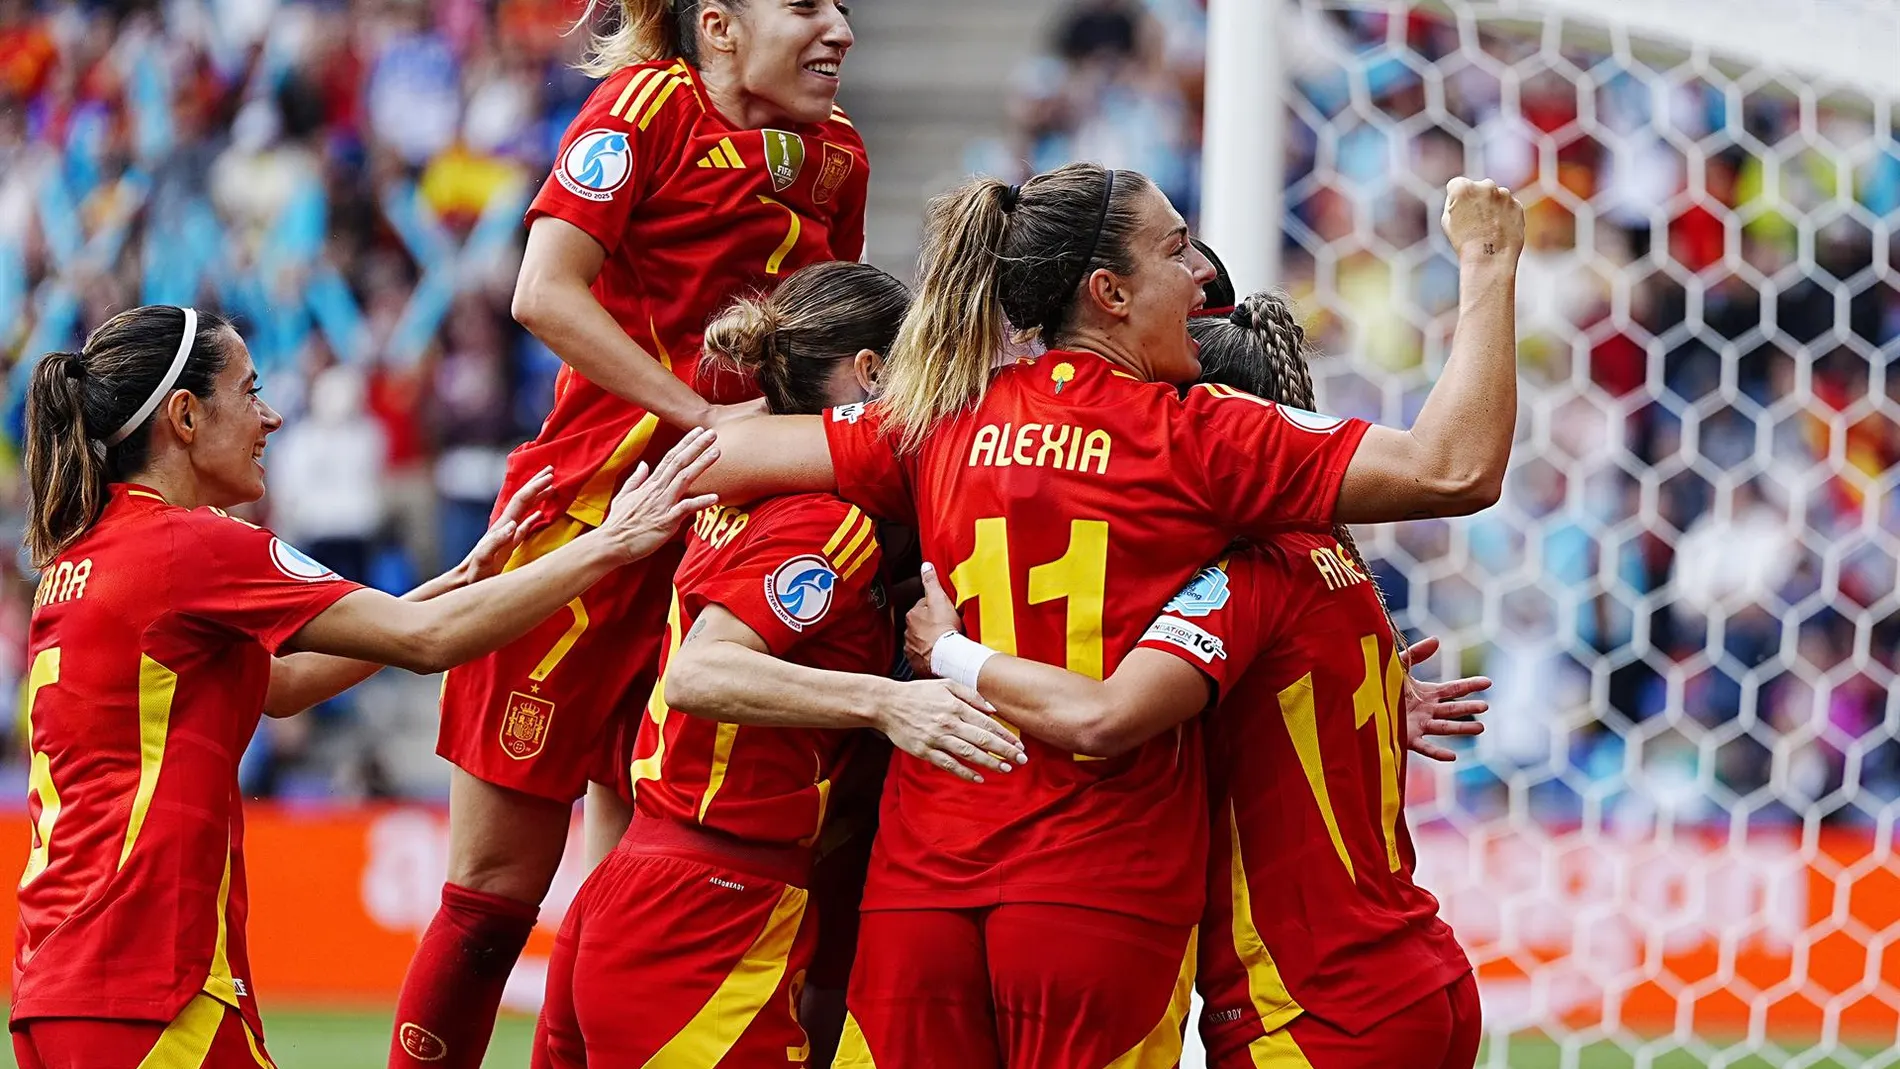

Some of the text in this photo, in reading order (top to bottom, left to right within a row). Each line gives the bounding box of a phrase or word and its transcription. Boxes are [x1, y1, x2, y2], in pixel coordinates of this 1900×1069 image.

[777, 165, 791, 177] FIFA
[756, 195, 800, 274] 7
[968, 423, 1112, 475] ALEXIA
[34, 558, 93, 607] ANA
[766, 577, 788, 621] SWITZERLAND
[949, 517, 1109, 762] 11
